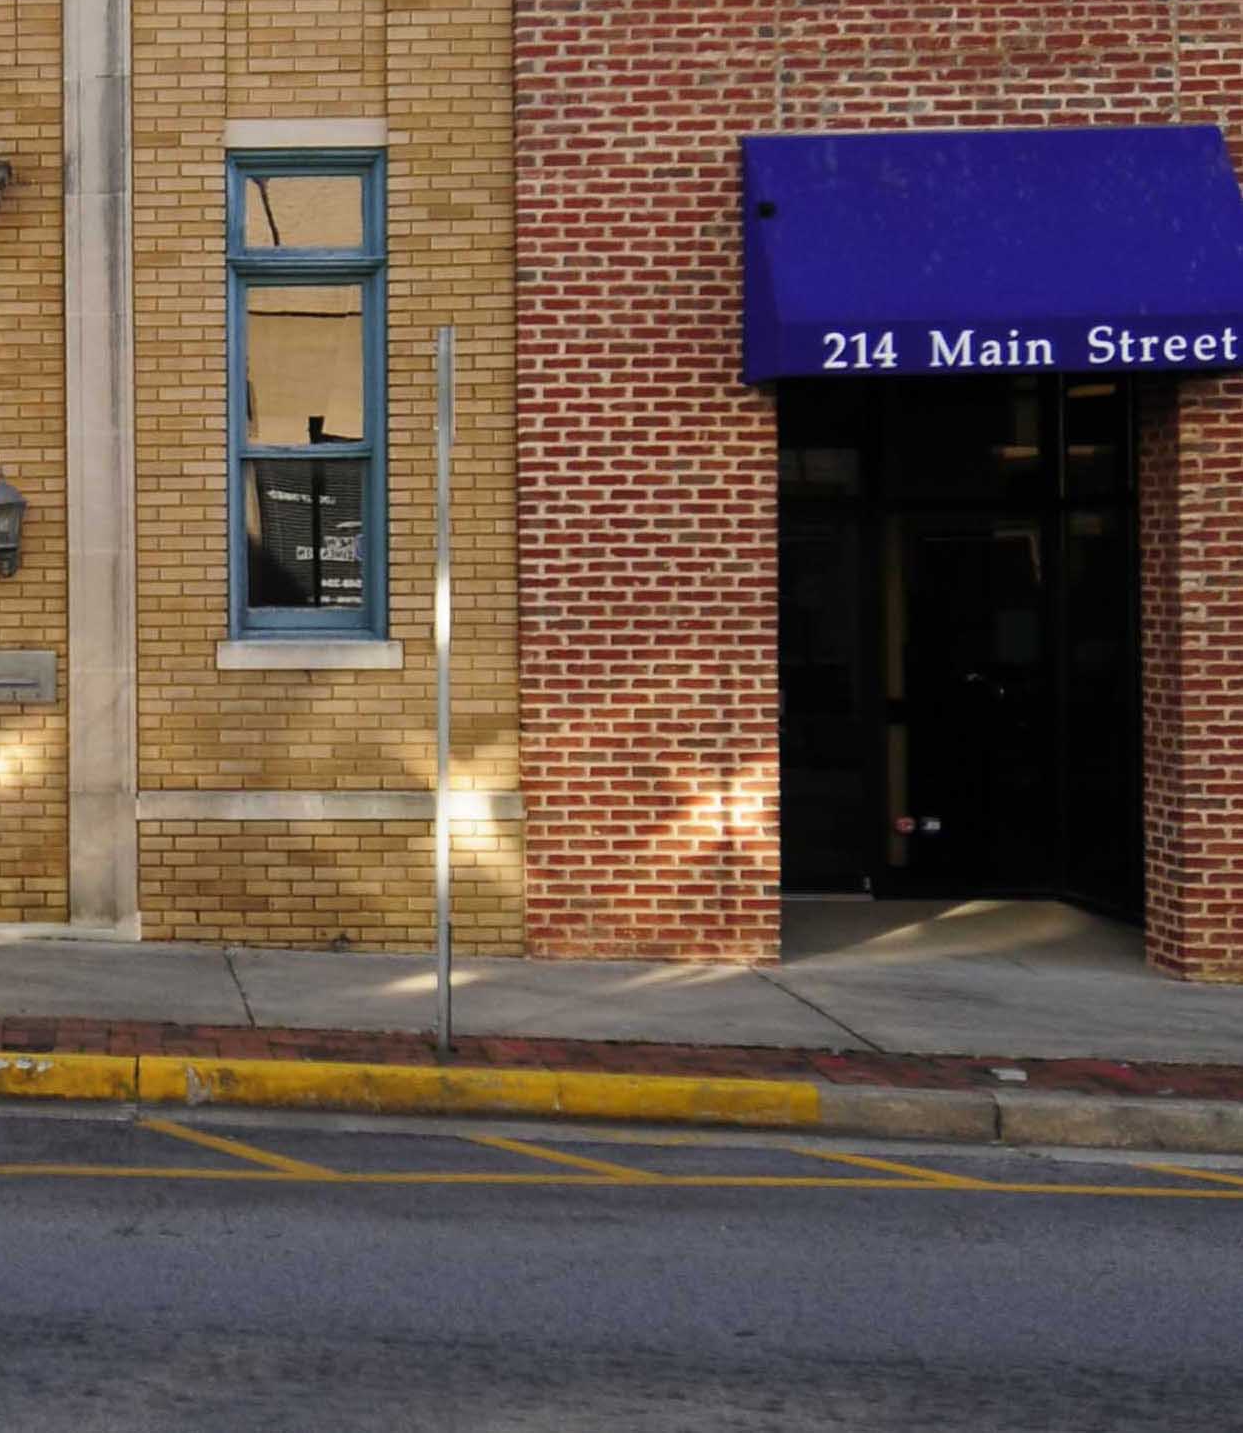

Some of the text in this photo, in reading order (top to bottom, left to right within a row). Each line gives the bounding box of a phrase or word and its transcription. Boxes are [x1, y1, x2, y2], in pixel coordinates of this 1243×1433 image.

[822, 324, 1239, 370] 214 Main Street
